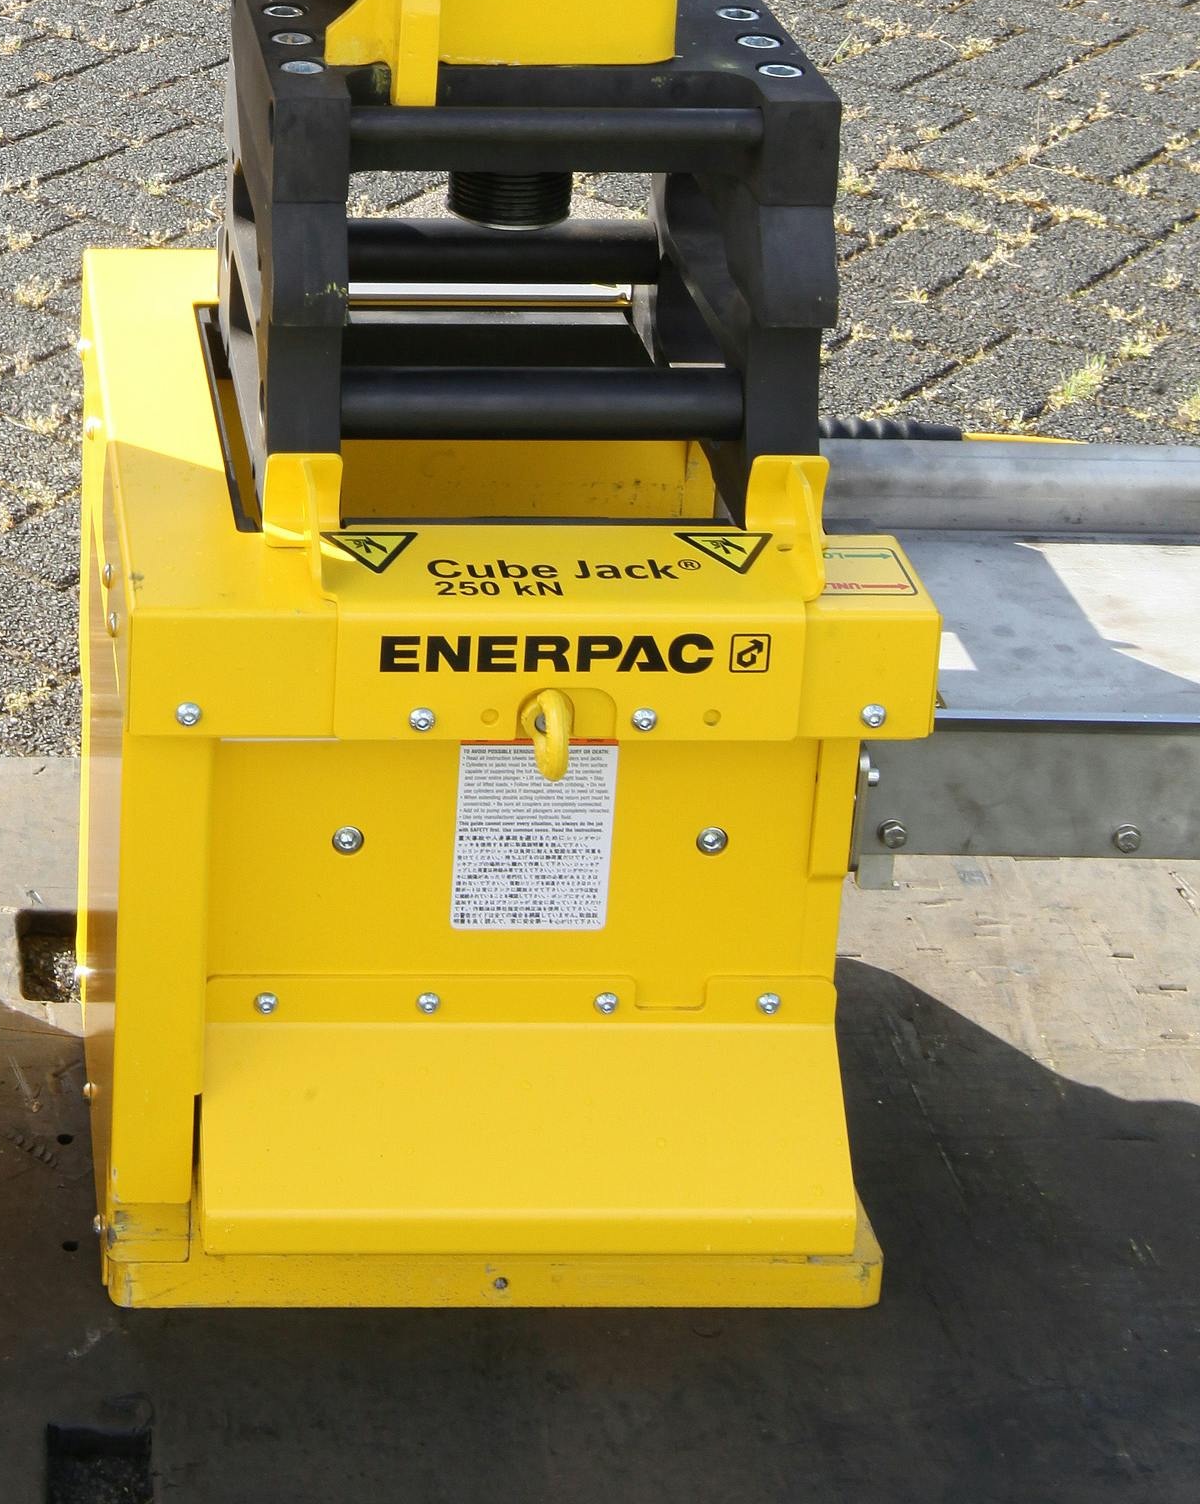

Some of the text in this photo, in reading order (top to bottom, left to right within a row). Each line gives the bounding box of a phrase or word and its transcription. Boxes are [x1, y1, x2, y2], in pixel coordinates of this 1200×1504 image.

[426, 559, 559, 579] Cube
[435, 580, 564, 597] 250 kN
[379, 632, 715, 674] ENERPAC
